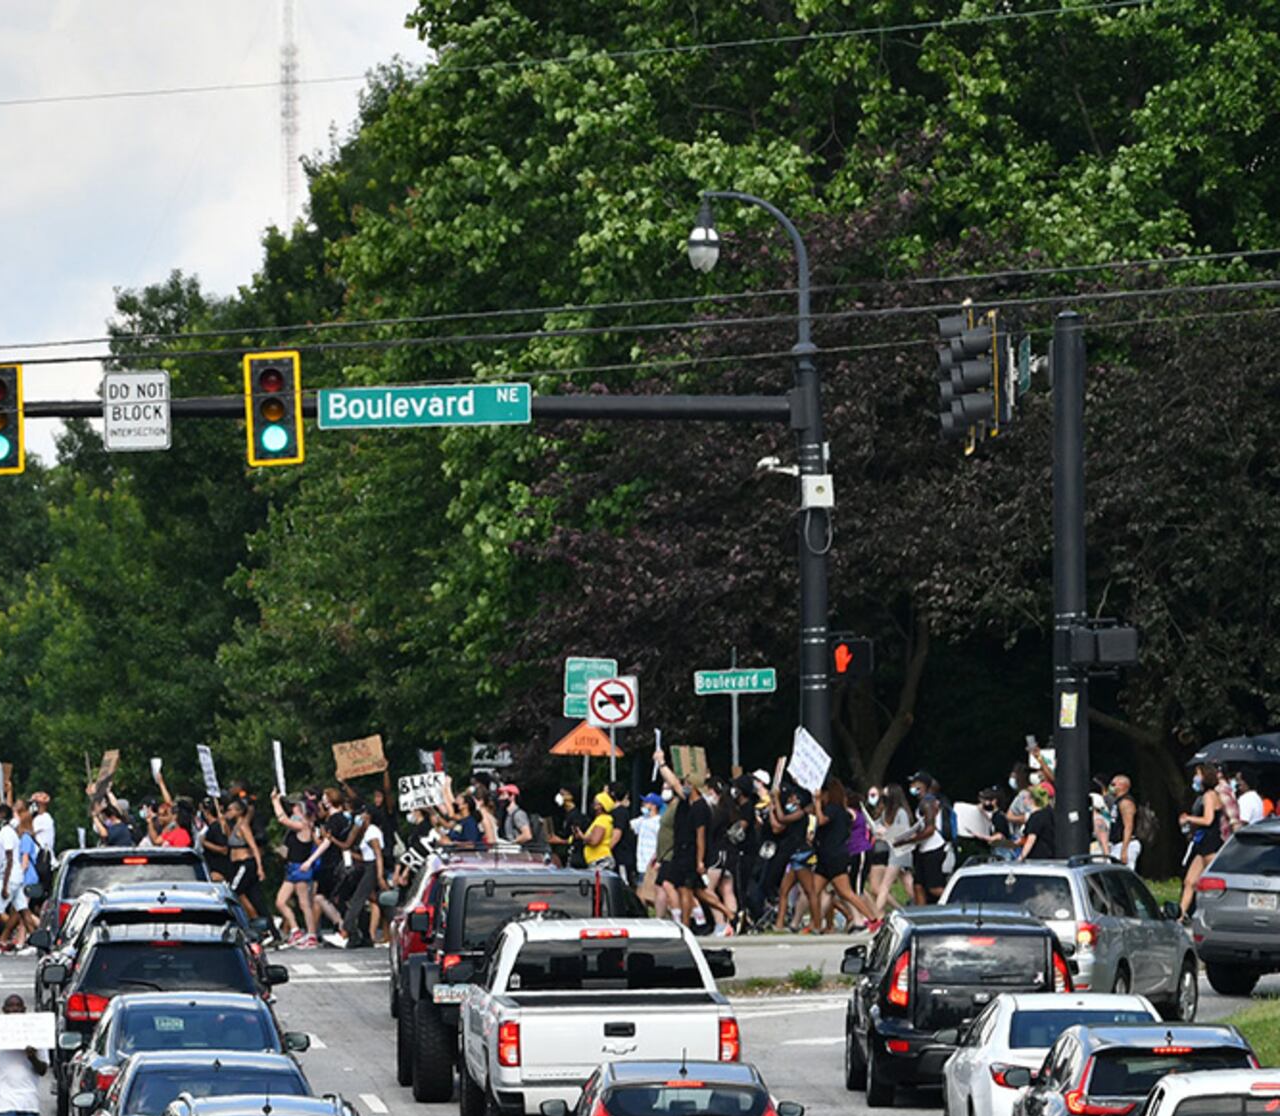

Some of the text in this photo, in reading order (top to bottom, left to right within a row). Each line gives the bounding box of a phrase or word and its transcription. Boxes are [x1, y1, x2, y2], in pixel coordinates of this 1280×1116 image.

[109, 382, 164, 399] DO NOT
[329, 388, 520, 420] Boulevard NE
[112, 405, 162, 421] BLOCK
[695, 673, 758, 689] Boulevard
[400, 773, 442, 795] BLACK
